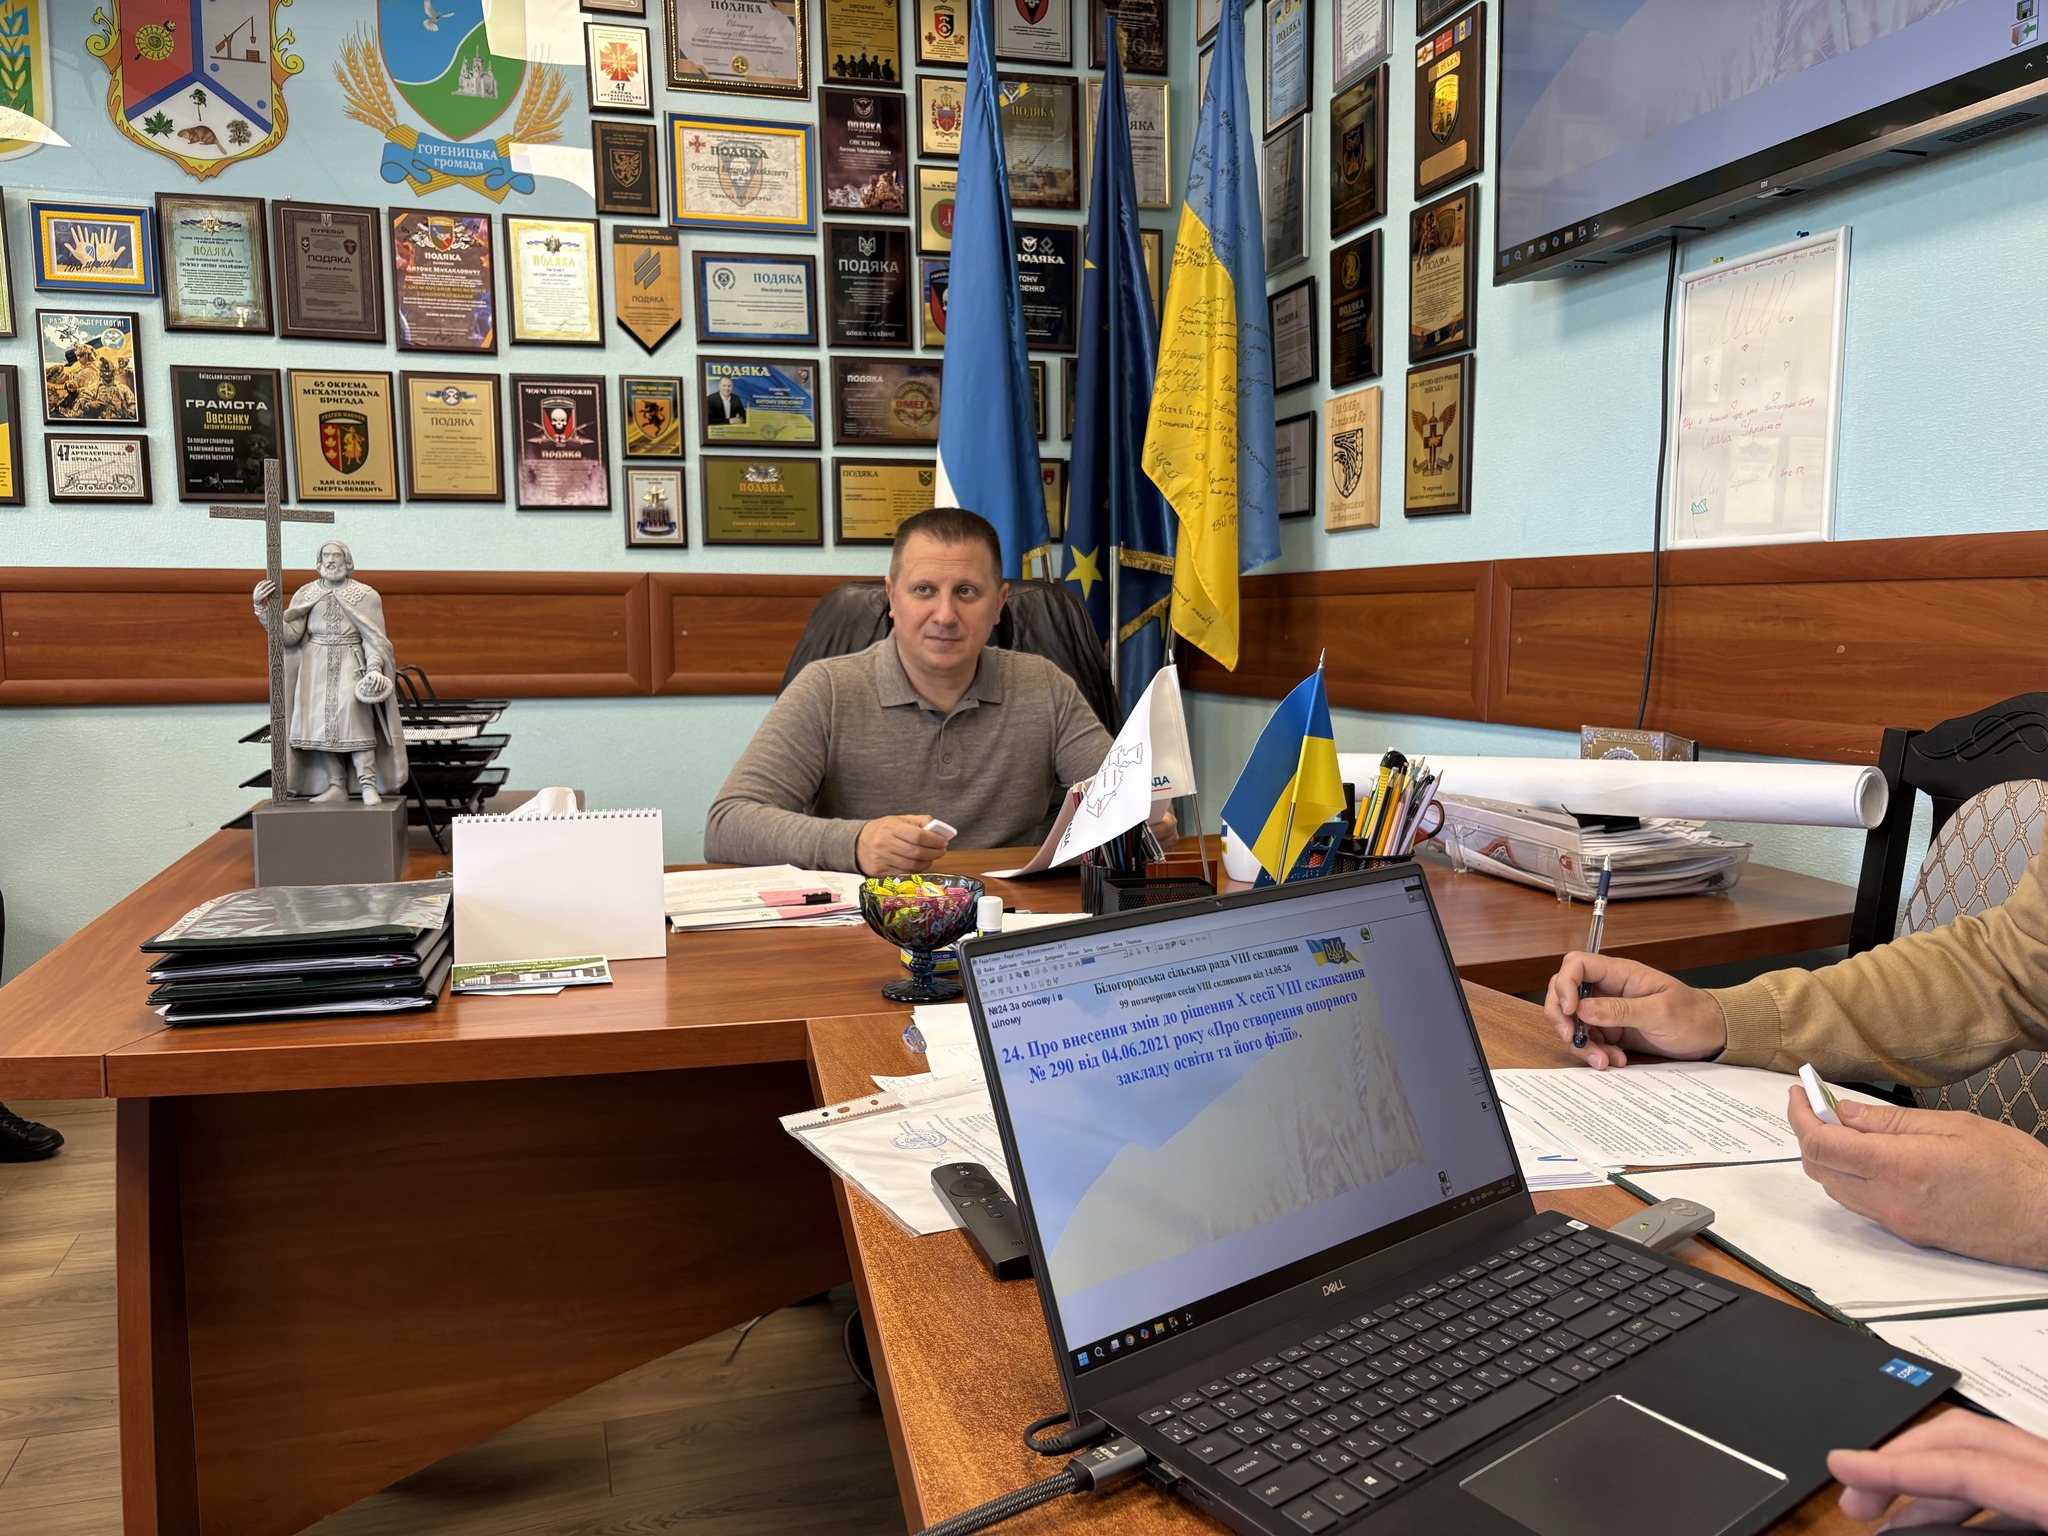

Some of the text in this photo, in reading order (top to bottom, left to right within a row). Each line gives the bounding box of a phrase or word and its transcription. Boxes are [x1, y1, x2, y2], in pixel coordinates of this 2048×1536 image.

[711, 0, 762, 14] ПОДЯКА
[1276, 19, 1301, 44] ПОДЯКА
[615, 82, 626, 91] 47
[1011, 106, 1055, 118] ПОДЯКА
[847, 120, 882, 133] ПОДЯКА
[1130, 120, 1155, 131] ЯКА
[418, 144, 498, 160] ГОРЕНИЦЬКА
[710, 146, 769, 159] ПОДЯКА
[434, 158, 484, 170] громада
[193, 246, 234, 257] ПОДЯКА
[424, 252, 461, 261] ПОДЯКА
[308, 254, 351, 264] ПОДЯКА
[533, 255, 575, 267] ПОДЯКА
[1425, 255, 1450, 271] ПОДЯКА
[838, 259, 899, 274] ПОДЯКА
[753, 273, 802, 285] ПОДЯКА
[1339, 299, 1365, 317] ПОДЯКА
[87, 318, 125, 328] ПЕРЕМОГИ!
[1276, 311, 1298, 327] ПОДЯКА
[712, 365, 771, 377] ПОДЯКА
[847, 375, 884, 383] ПОДЯКА
[1410, 373, 1459, 390] ДЕСАНТНО-ШТУРМОВІ
[1424, 386, 1444, 394] ВІЙСЬКА
[185, 399, 268, 410] ГРАМОТА
[895, 401, 933, 409] ОМЕГА
[206, 411, 250, 425] ОВСІЄНКУ
[431, 417, 475, 427] ПОДЯКА
[57, 444, 70, 461] 47
[541, 451, 581, 459] ПОДЯКА
[842, 470, 879, 478] ПОДЯКА
[739, 483, 785, 493] ПОДЯКА
[1094, 944, 1299, 995] Білогородська сільська рада VIII скликання
[1119, 964, 1292, 1009] 99 позачергова сесія VIII скликання від 14.05.26
[988, 1004, 1008, 1016] №24
[1009, 1002, 1020, 1012] За
[1022, 997, 1050, 1009] основу
[991, 1015, 1022, 1029] цілому
[1002, 968, 1366, 1064] 24. Про внесення змін до рішення X сесії VIII скликання
[1029, 992, 1358, 1083] № 290 від 04.06.2021 року «Про створення опорного
[1116, 1027, 1302, 1086] закладу освіти та його філії».
[1504, 1269, 1525, 1280] backspace
[1322, 1279, 1346, 1297] DELL
[1202, 1445, 1214, 1454] tab
[1265, 1485, 1280, 1496] shift
